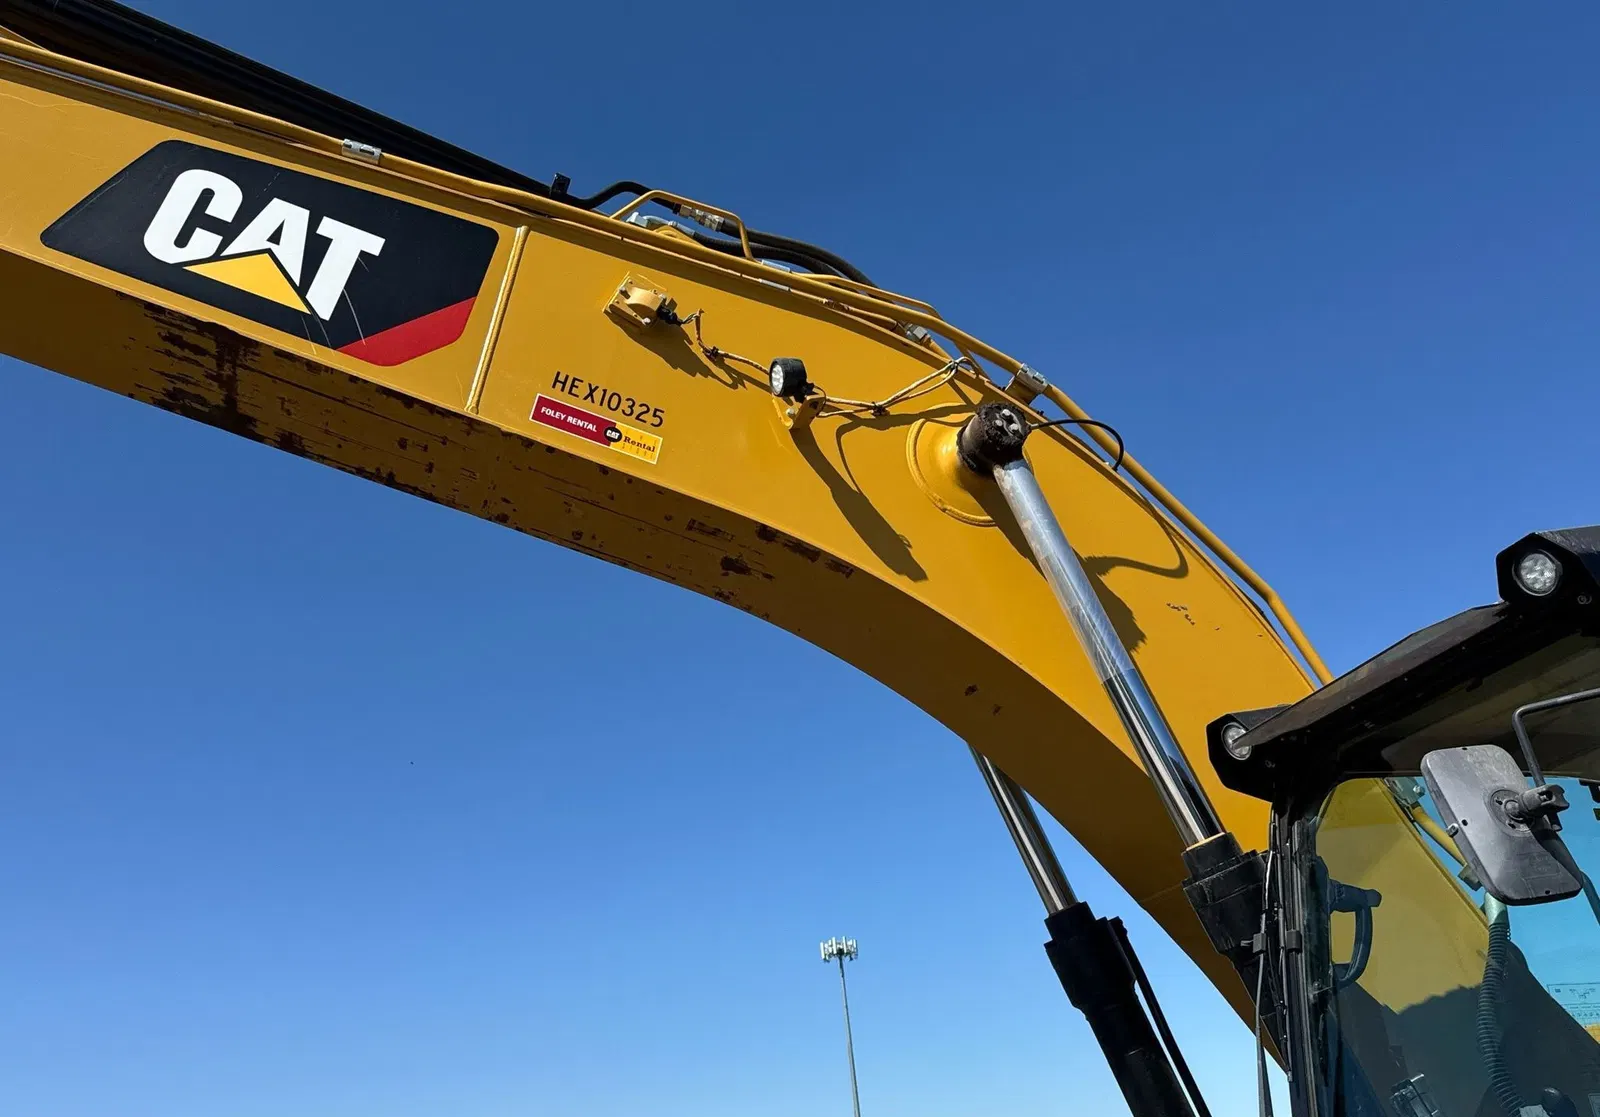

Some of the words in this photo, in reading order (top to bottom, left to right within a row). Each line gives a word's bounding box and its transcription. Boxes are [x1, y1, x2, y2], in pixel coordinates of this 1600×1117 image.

[144, 169, 386, 321] CAT
[540, 406, 566, 421] FOLEY
[566, 415, 597, 433] RENTAL
[551, 371, 665, 428] HEX10325
[606, 429, 620, 440] CAT
[623, 436, 656, 453] Rental
